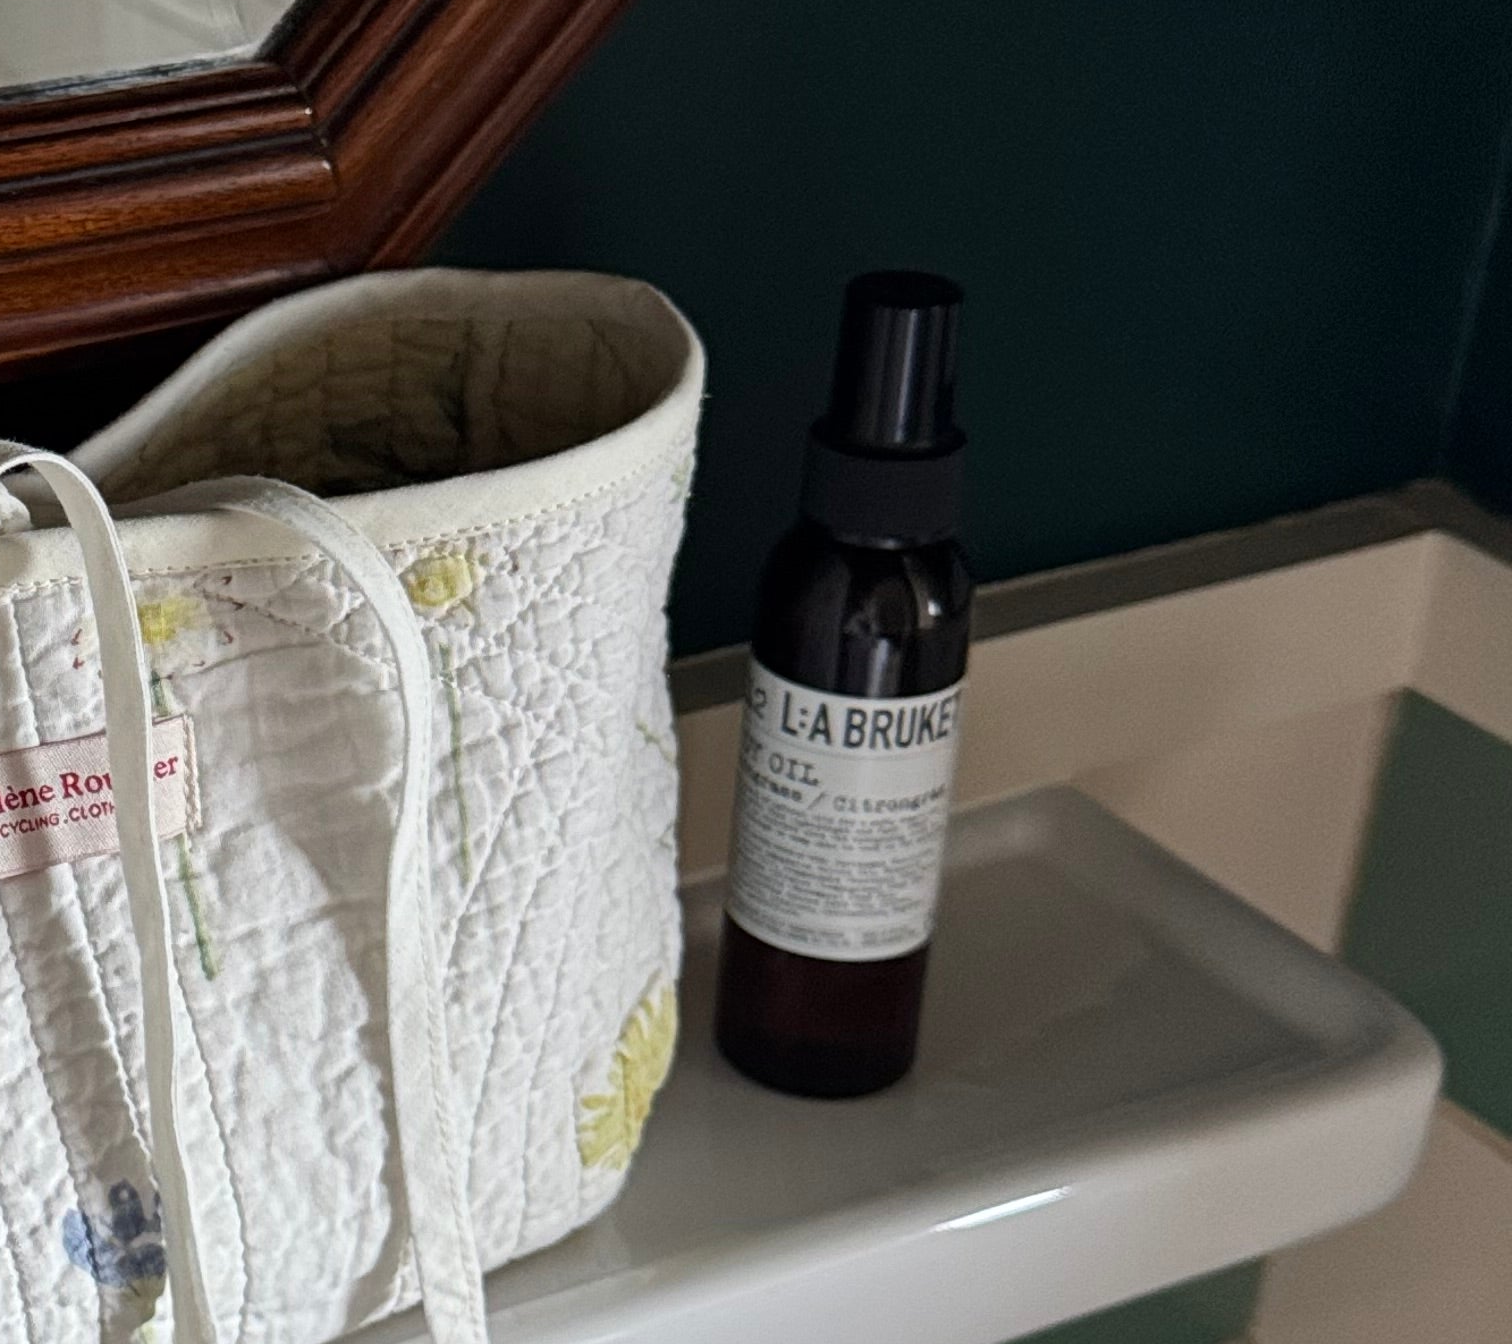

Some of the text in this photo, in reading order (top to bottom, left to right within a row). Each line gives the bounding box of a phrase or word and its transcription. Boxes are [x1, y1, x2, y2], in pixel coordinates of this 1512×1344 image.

[781, 690, 832, 745] L:A
[59, 755, 179, 799] Roer
[769, 752, 819, 786] OIL
